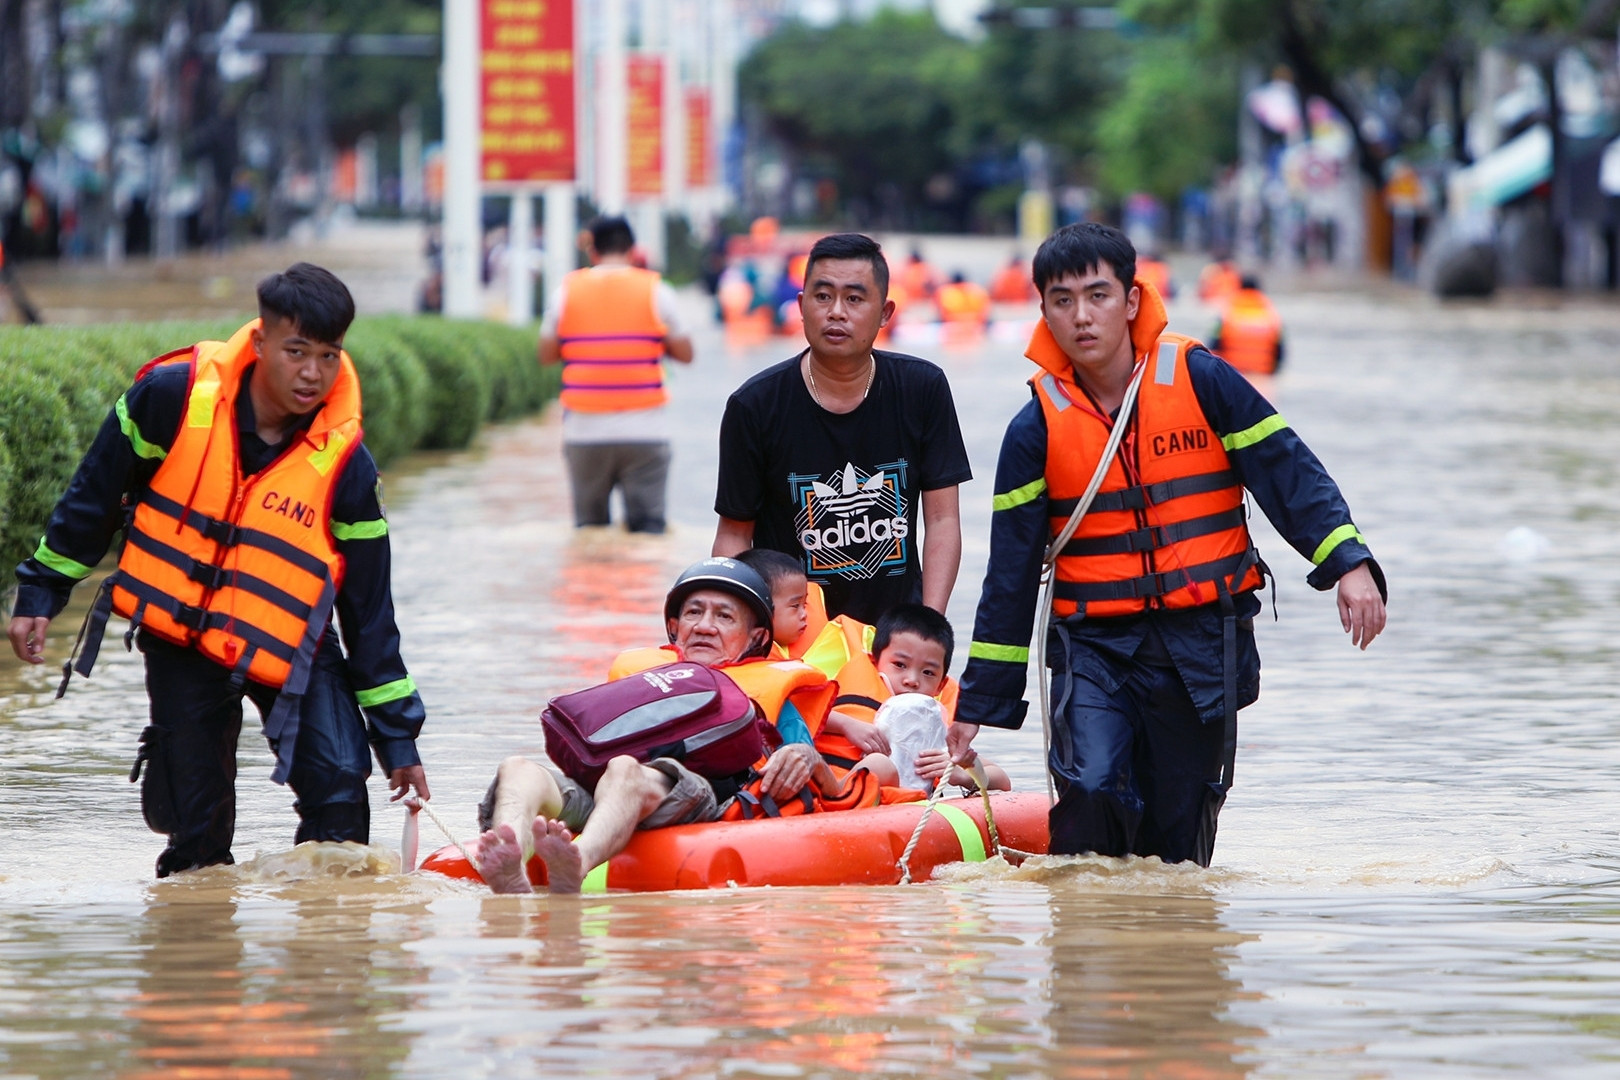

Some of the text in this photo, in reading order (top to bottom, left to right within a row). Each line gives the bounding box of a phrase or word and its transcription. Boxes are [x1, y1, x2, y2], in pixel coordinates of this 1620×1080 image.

[1153, 429, 1209, 457] CAND
[261, 491, 316, 529] CAND
[801, 515, 909, 551] adidas
